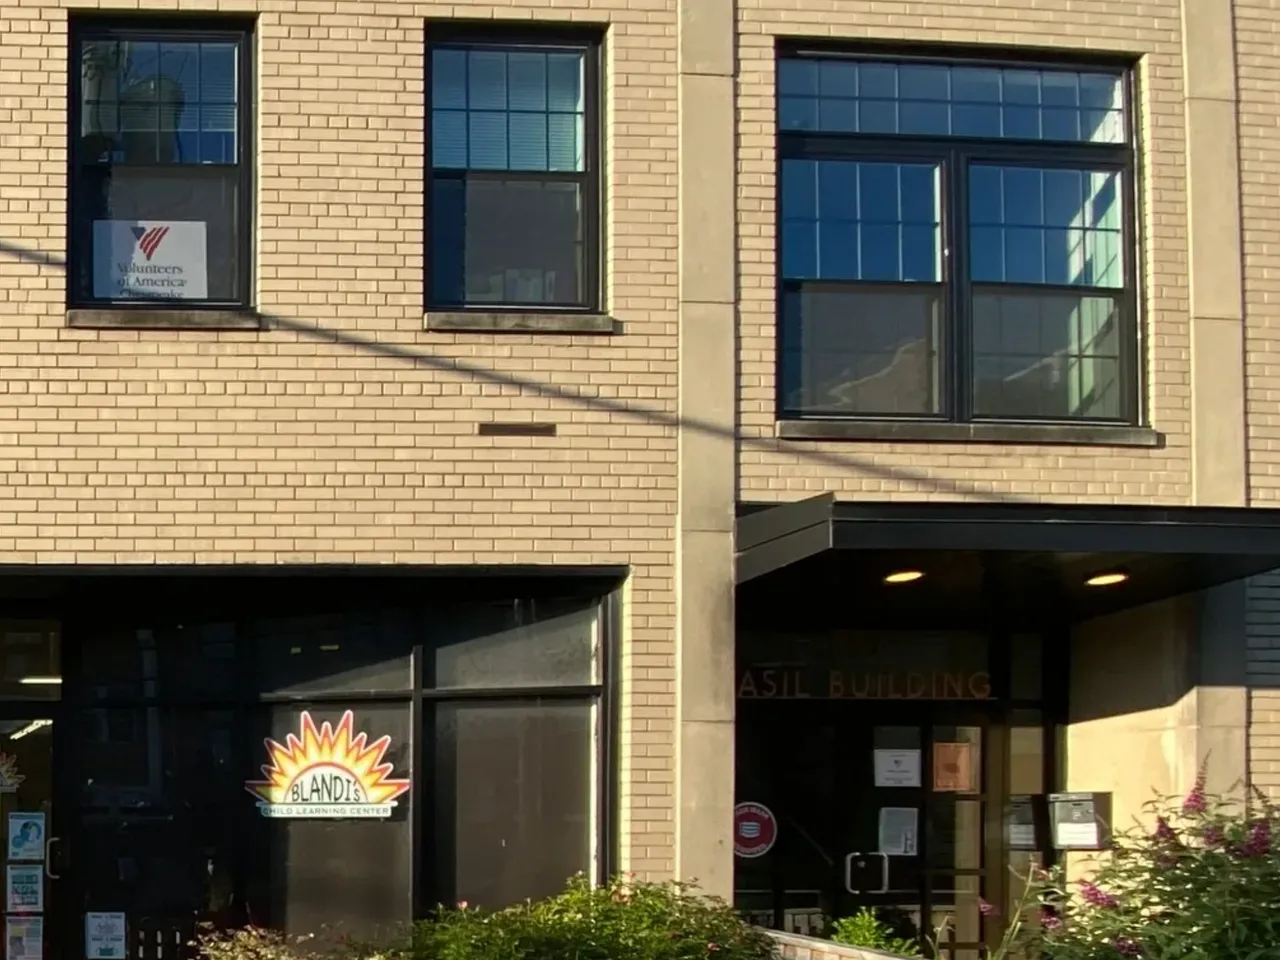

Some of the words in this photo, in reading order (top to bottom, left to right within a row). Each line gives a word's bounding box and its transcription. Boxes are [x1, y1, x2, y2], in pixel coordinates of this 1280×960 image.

[117, 262, 184, 274] Volunteers
[117, 275, 129, 288] of
[134, 276, 185, 287] America
[829, 670, 991, 698] BUILDING
[262, 806, 293, 816] CHILD
[296, 806, 347, 816] LEARNING
[350, 805, 390, 815] CENTER
